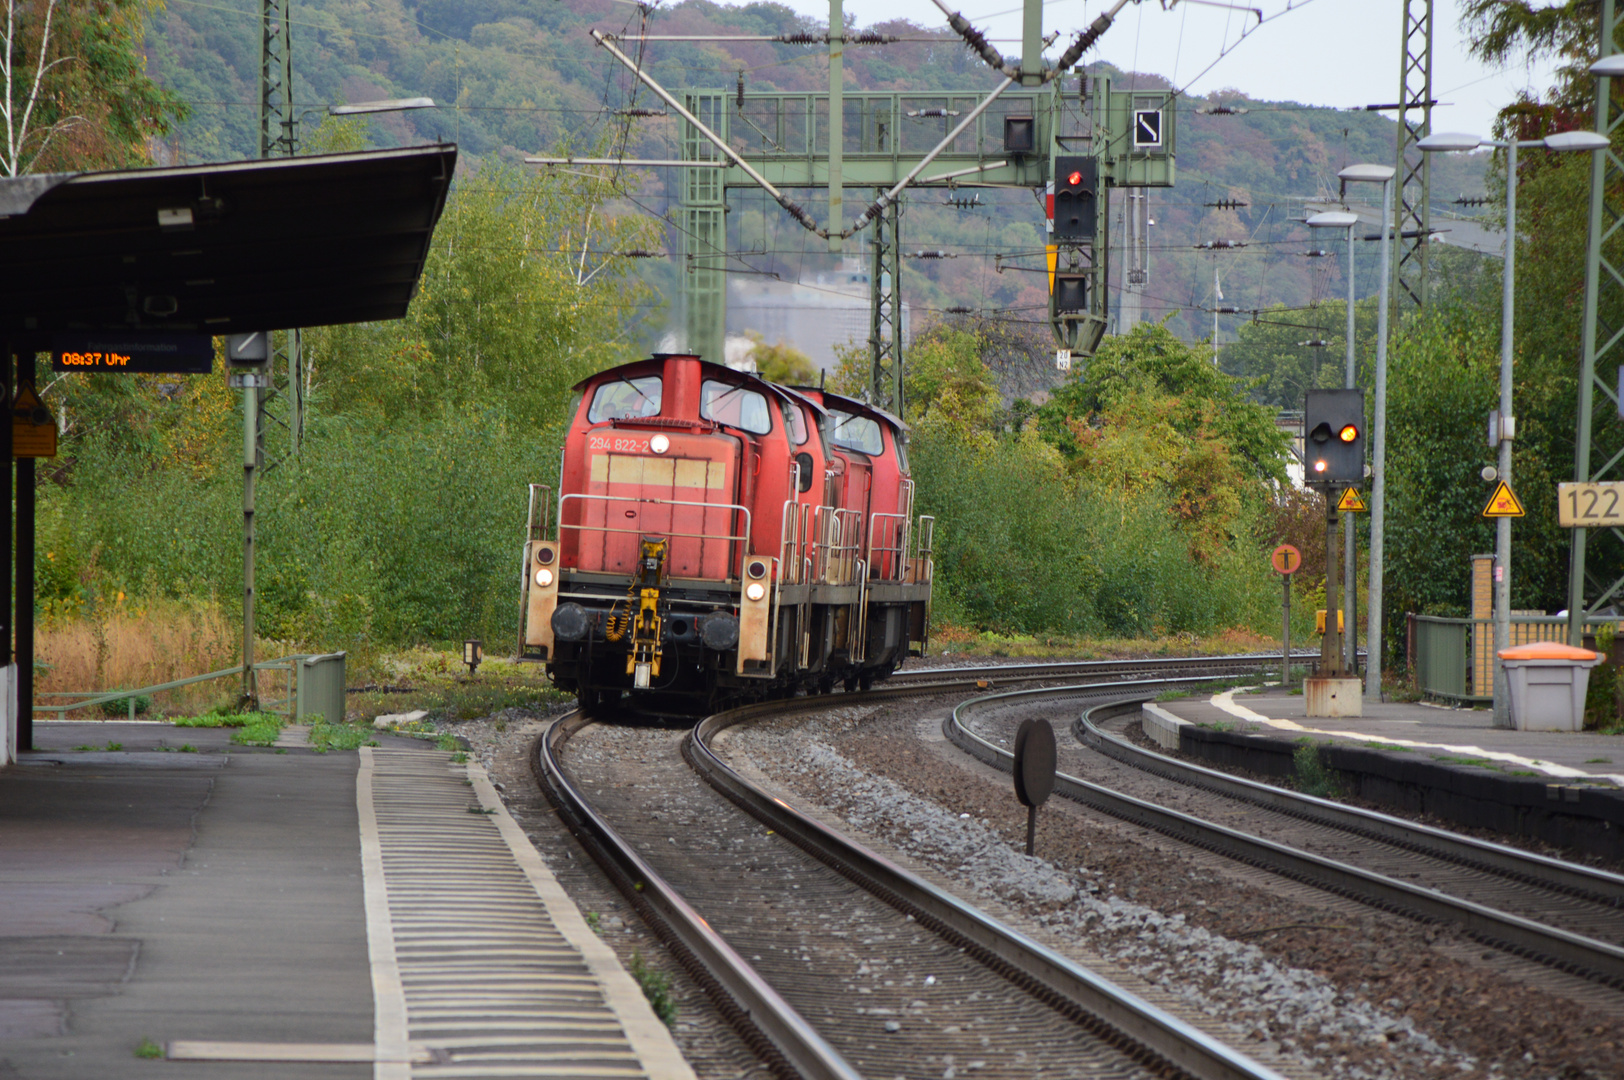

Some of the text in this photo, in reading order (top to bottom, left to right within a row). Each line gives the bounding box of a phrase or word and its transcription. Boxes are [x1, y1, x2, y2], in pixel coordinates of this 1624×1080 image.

[87, 342, 177, 353] Fahrgastinformation
[61, 352, 131, 366] 08:37 Uhr
[1059, 361, 1068, 369] N2
[590, 437, 649, 453] 294 822-2
[1568, 489, 1619, 519] 122
